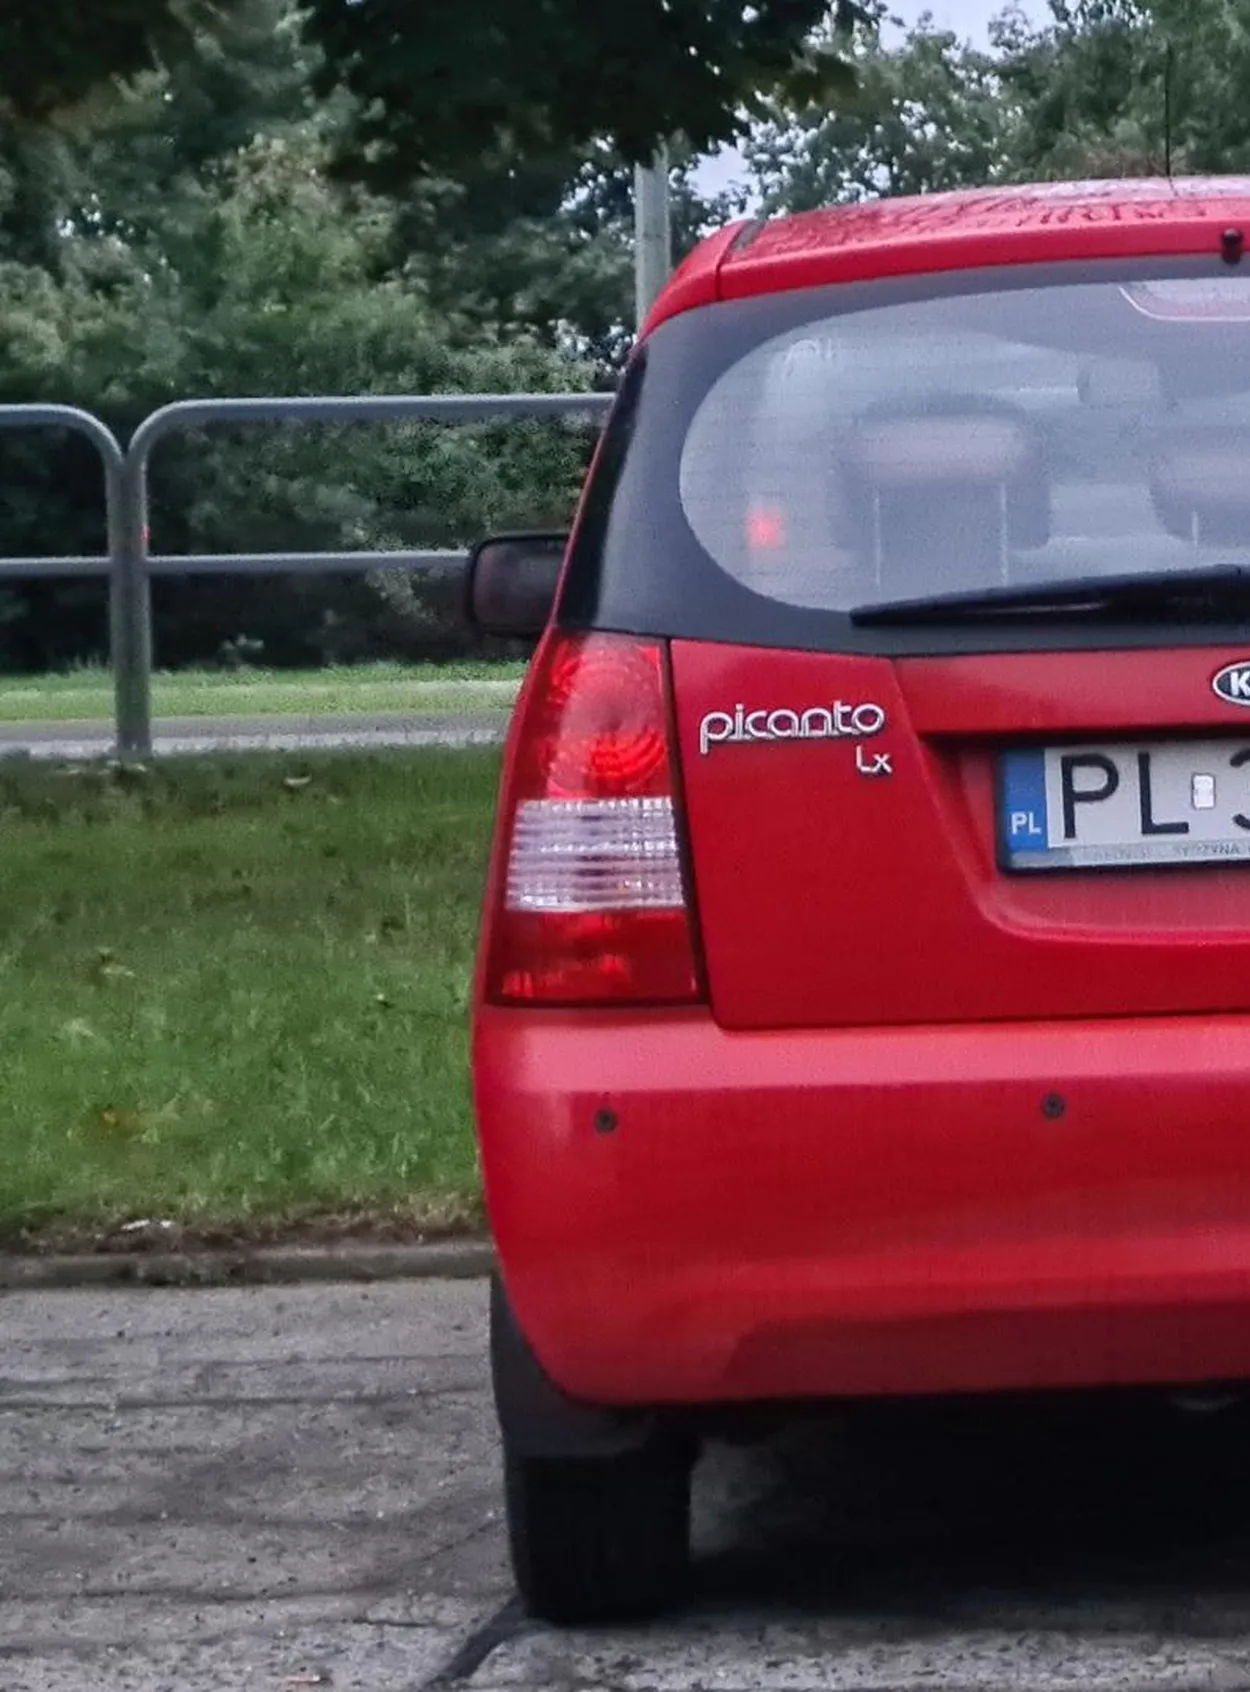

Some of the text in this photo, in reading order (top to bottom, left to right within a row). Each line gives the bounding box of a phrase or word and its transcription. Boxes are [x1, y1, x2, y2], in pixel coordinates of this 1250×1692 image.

[700, 700, 885, 755] picanto
[1010, 811, 1042, 835] PL
[1061, 752, 1190, 839] PL
